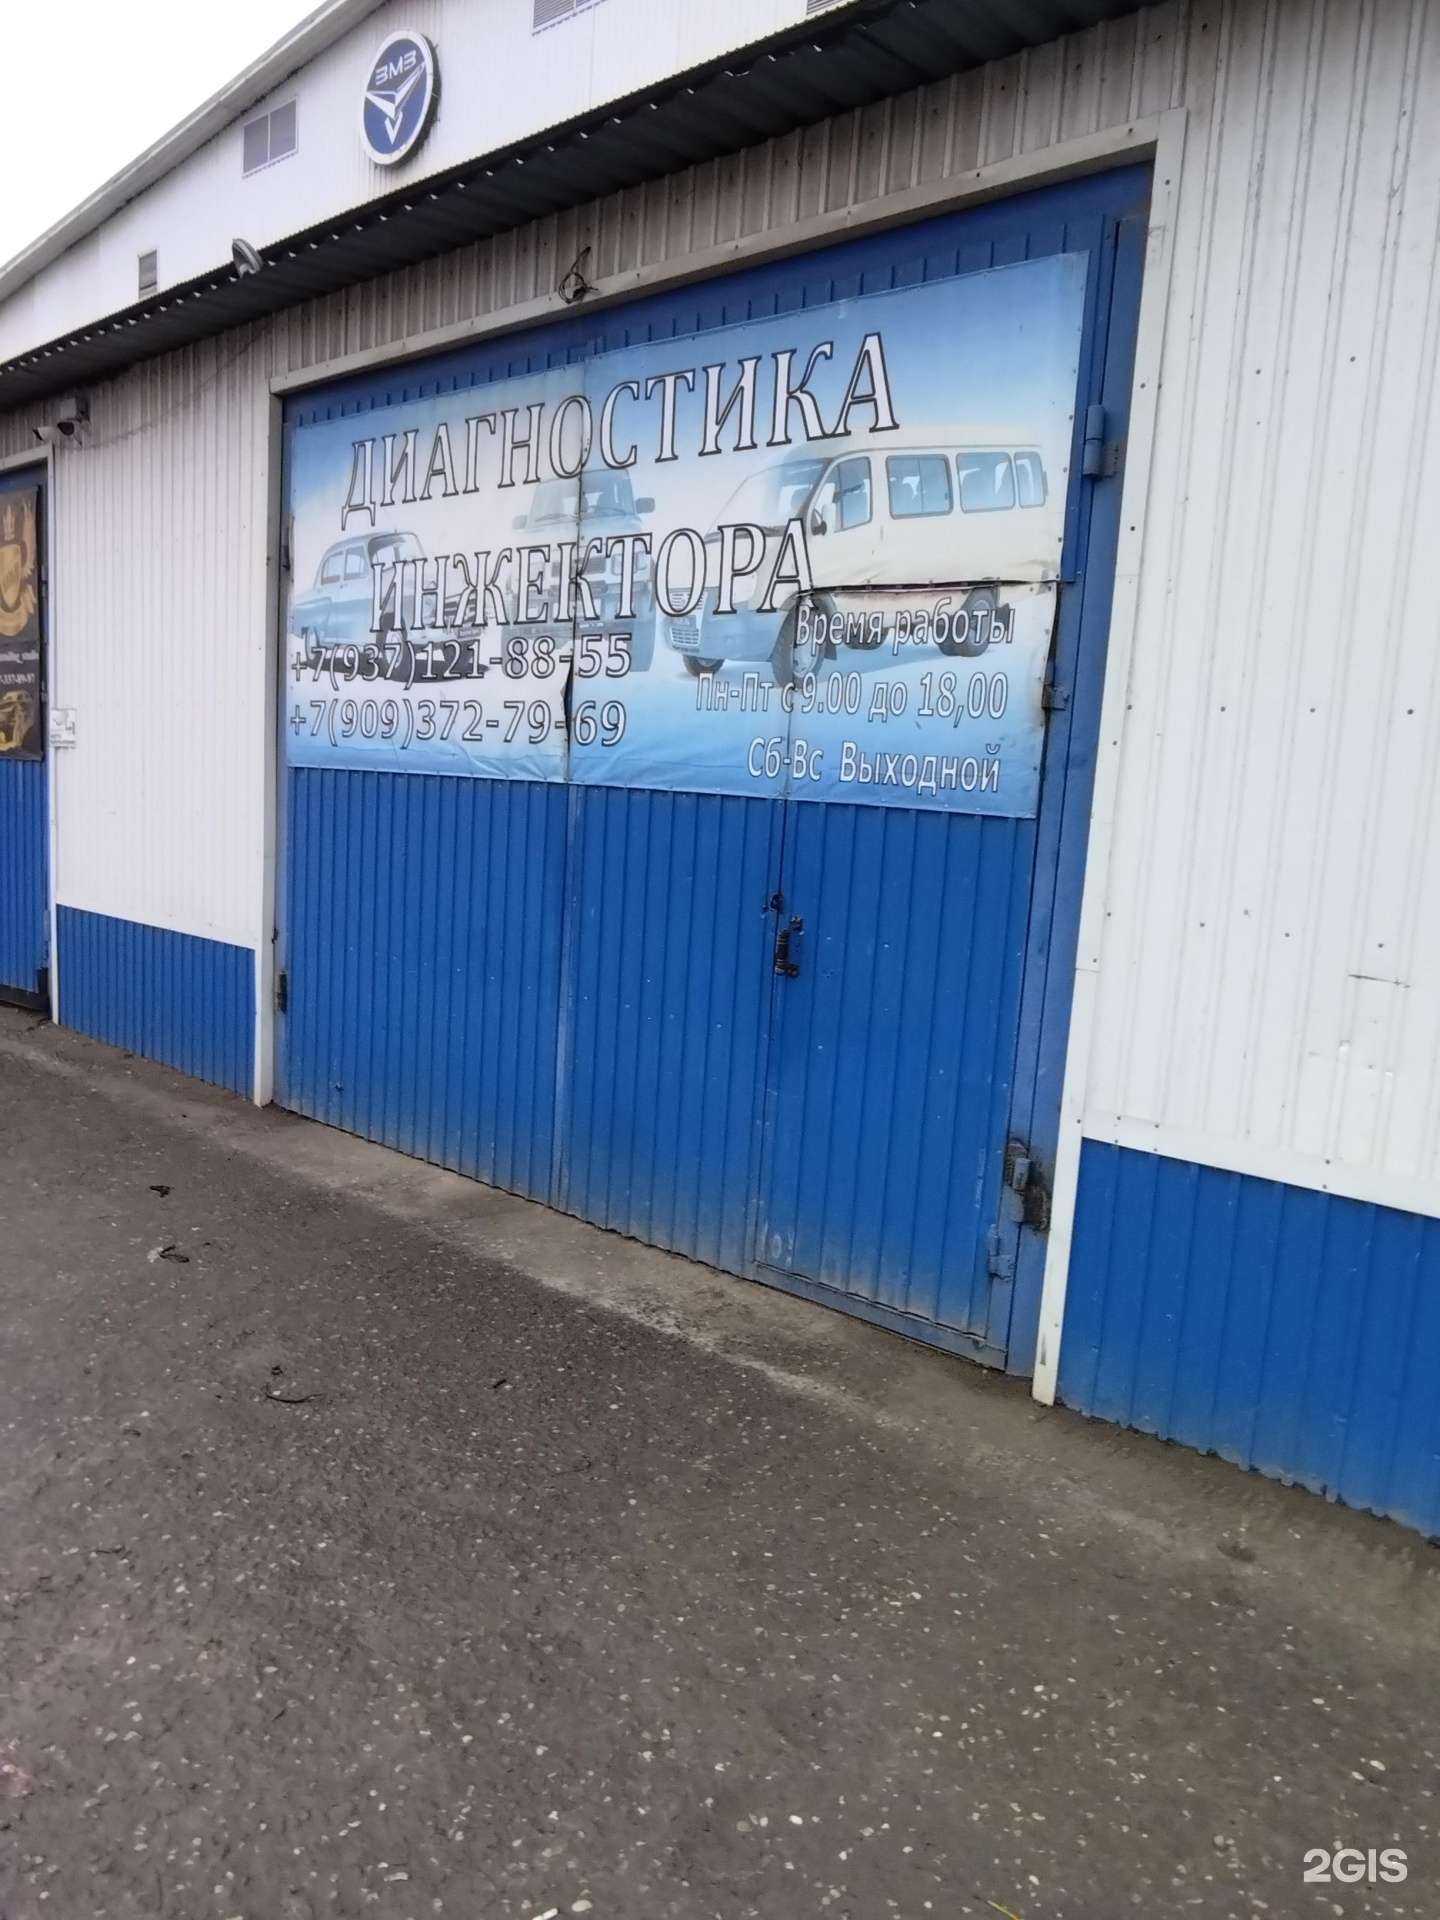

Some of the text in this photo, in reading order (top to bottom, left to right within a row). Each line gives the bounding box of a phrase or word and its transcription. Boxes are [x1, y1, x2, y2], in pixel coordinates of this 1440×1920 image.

[341, 332, 900, 531] ДИАГНОСТИКА
[370, 517, 820, 633] ИНЖЕКТОРА
[795, 597, 1016, 657] Время работы
[291, 633, 632, 691] +7(937)121-88-55
[290, 699, 627, 750] +7(909)372-79-69
[696, 671, 775, 712] Пн-Пт
[868, 680, 909, 723] до
[917, 671, 1009, 729] 18,00
[747, 736, 1001, 797] Сб-Вс Выходной
